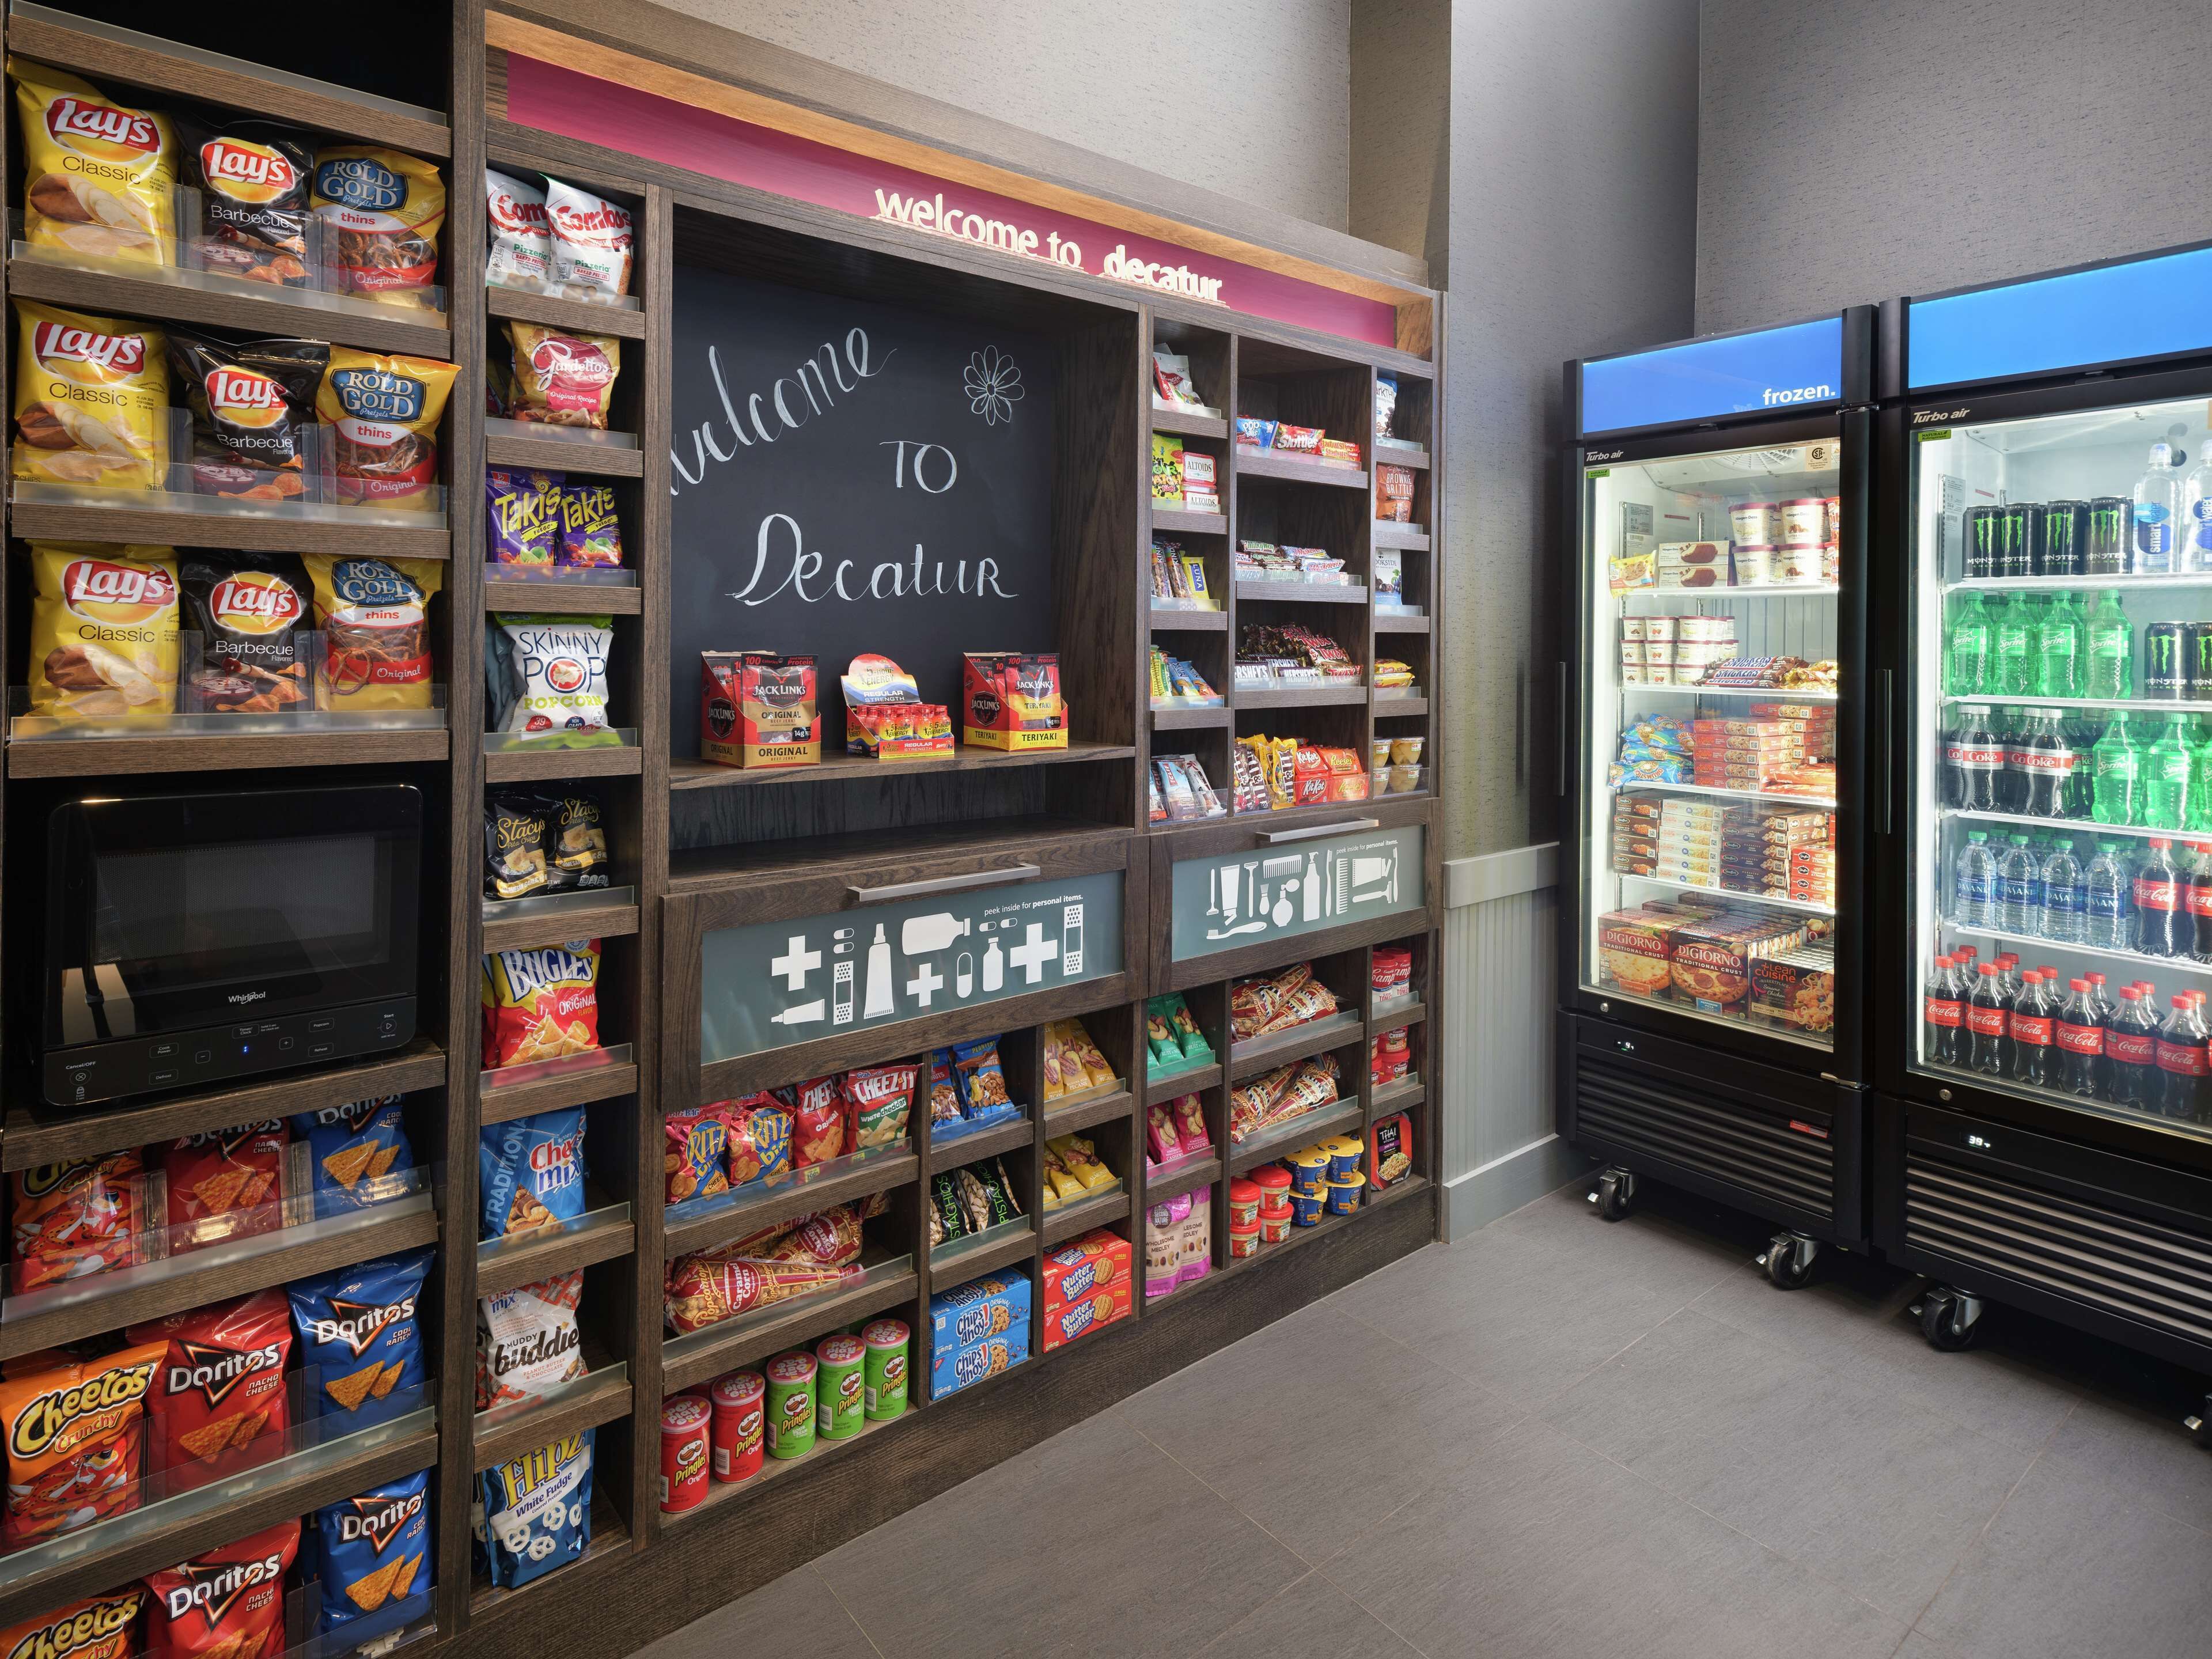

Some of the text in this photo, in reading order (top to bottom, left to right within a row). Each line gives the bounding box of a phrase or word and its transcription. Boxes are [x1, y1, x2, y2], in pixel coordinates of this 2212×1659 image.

[52, 99, 154, 146] Lay's
[62, 156, 141, 186] Classic
[208, 145, 289, 186] Lay's
[333, 158, 396, 189] ROLD
[321, 175, 399, 209] GOLD
[211, 205, 290, 229] Barbecue
[340, 211, 376, 225] thins
[556, 201, 632, 232] Combos
[513, 244, 548, 260] Pizzeria
[873, 188, 1223, 303] welcome to decatur
[575, 259, 610, 273] Pizzeria
[354, 271, 404, 286] Original
[42, 321, 145, 370] Lay's
[531, 340, 609, 392] Gardetto's
[211, 372, 288, 410] Lay's
[347, 370, 406, 396] ROLD
[49, 382, 128, 407] Classic
[342, 387, 415, 418] GOLD
[550, 391, 597, 404] Original Recipe
[1763, 384, 1836, 406] frozen.
[359, 407, 389, 419] Pretzels
[1913, 408, 1971, 425] Turbo air
[357, 425, 393, 440] thins
[217, 434, 294, 450] Barbecue
[1277, 434, 1319, 449] Skittles
[1586, 450, 1624, 461] Turbo air
[880, 441, 957, 494] TO
[1187, 460, 1213, 473] ALTOIDS
[370, 476, 418, 493] Original
[1386, 473, 1411, 484] BROWNIE
[1386, 484, 1412, 495] BRITTLE
[494, 481, 562, 540] Takis
[559, 486, 615, 533] Takis
[72, 563, 168, 605] Lay's
[1192, 563, 1203, 589] LUNA
[218, 581, 293, 617] Lay's
[342, 578, 418, 603] GOLD
[365, 593, 396, 605] Pretzels
[365, 609, 400, 621] thins
[78, 624, 155, 643] Classic
[519, 627, 603, 656] SKINNY
[1953, 635, 1976, 646] Sprite
[2000, 637, 2025, 647] Sprite
[2041, 635, 2068, 646] Sprite
[215, 639, 294, 656] Barbecue
[2090, 637, 2118, 649] Sprite
[271, 654, 294, 662] Flavored
[745, 656, 761, 665] 100
[1316, 648, 1345, 661] TWIX
[376, 664, 422, 680] Original
[523, 656, 607, 695] POP
[1715, 669, 1760, 678] SNICKERS
[752, 685, 806, 696] JACK LINK'S
[2145, 678, 2188, 686] MONSTER
[524, 695, 604, 710] POPCORN
[534, 717, 547, 725] 39
[975, 730, 997, 741] TERIYAKI
[1022, 733, 1057, 741] TERIYAKI
[711, 744, 733, 755] ORIGINAL
[758, 747, 808, 757] ORIGINAL
[1968, 751, 1998, 763] Coke
[1330, 755, 1353, 766] Reese's
[2027, 755, 2055, 768] Coke
[2097, 760, 2130, 771] Sprite
[497, 817, 546, 849] Stacy's
[521, 835, 536, 845] Chips
[1366, 840, 1385, 850] personal
[1957, 882, 1990, 894] DASANI
[2000, 885, 2036, 896] DASANI
[2134, 884, 2177, 903] Coca-Cola
[984, 907, 1000, 917] peek
[1001, 903, 1020, 913] inside
[1032, 896, 1062, 908] personal
[1063, 894, 1084, 903] items.
[1606, 931, 1662, 950] DIGIORNO
[1603, 942, 1665, 959] TRADITIONAL CRUST
[1677, 945, 1741, 968] DIGIORNO
[1675, 957, 1743, 975] TRADITIONAL CRUST
[499, 948, 594, 1003] BUGLES
[1763, 983, 1781, 992] Sesame
[1767, 990, 1786, 999] Chicken
[228, 991, 266, 1004] Whirlpool
[558, 992, 596, 1016] ORIGINAL
[578, 1006, 593, 1016] FLAVOR
[1928, 1005, 1961, 1018] Coca-Cola
[1967, 1011, 2001, 1027] Coca-Cola
[2009, 1018, 2043, 1036] Coca-Cola
[2056, 1027, 2100, 1047] Coca-Cola
[2118, 1040, 2155, 1055] Coca-Cola
[2156, 1046, 2195, 1065] Coca-Cola
[66, 1060, 97, 1070] Cancel/OFF
[880, 1097, 906, 1117] cheddar
[748, 1112, 791, 1152] RITZ
[1380, 1127, 1396, 1140] THAI
[687, 1124, 729, 1164] RITZ
[1187, 1142, 1209, 1151] CASHEWS
[537, 1156, 581, 1195] mix
[1146, 1236, 1175, 1247] WHOLESOME
[1151, 1244, 1171, 1253] MEDLEY
[733, 1262, 743, 1309] Caramel
[741, 1268, 750, 1298] Corn
[1062, 1262, 1092, 1292] Nutter
[1066, 1270, 1096, 1302] Butter
[990, 1298, 1010, 1307] ORIGINAL
[317, 1297, 415, 1344] Doritos
[956, 1308, 984, 1336] Chips
[1061, 1300, 1092, 1328] Nutter
[1066, 1307, 1095, 1339] Butter
[386, 1332, 412, 1347] RANCH
[392, 1327, 411, 1339] COOL
[506, 1332, 537, 1350] MUDDY
[988, 1336, 1009, 1347] ORIGINAL
[169, 1343, 280, 1395] Doritos
[955, 1347, 982, 1376] Chips
[246, 1379, 279, 1398] CHEESE
[248, 1373, 279, 1390] NACHO
[881, 1365, 908, 1398] Pringles
[838, 1385, 864, 1415] Pringles
[13, 1363, 158, 1459] Cheetos
[781, 1406, 812, 1435] Pringles
[54, 1409, 121, 1453] Crunchy
[735, 1423, 763, 1459] Pringles
[674, 1452, 706, 1487] Pringles
[516, 1471, 573, 1517] White Fudge
[169, 1554, 281, 1619] Doritos
